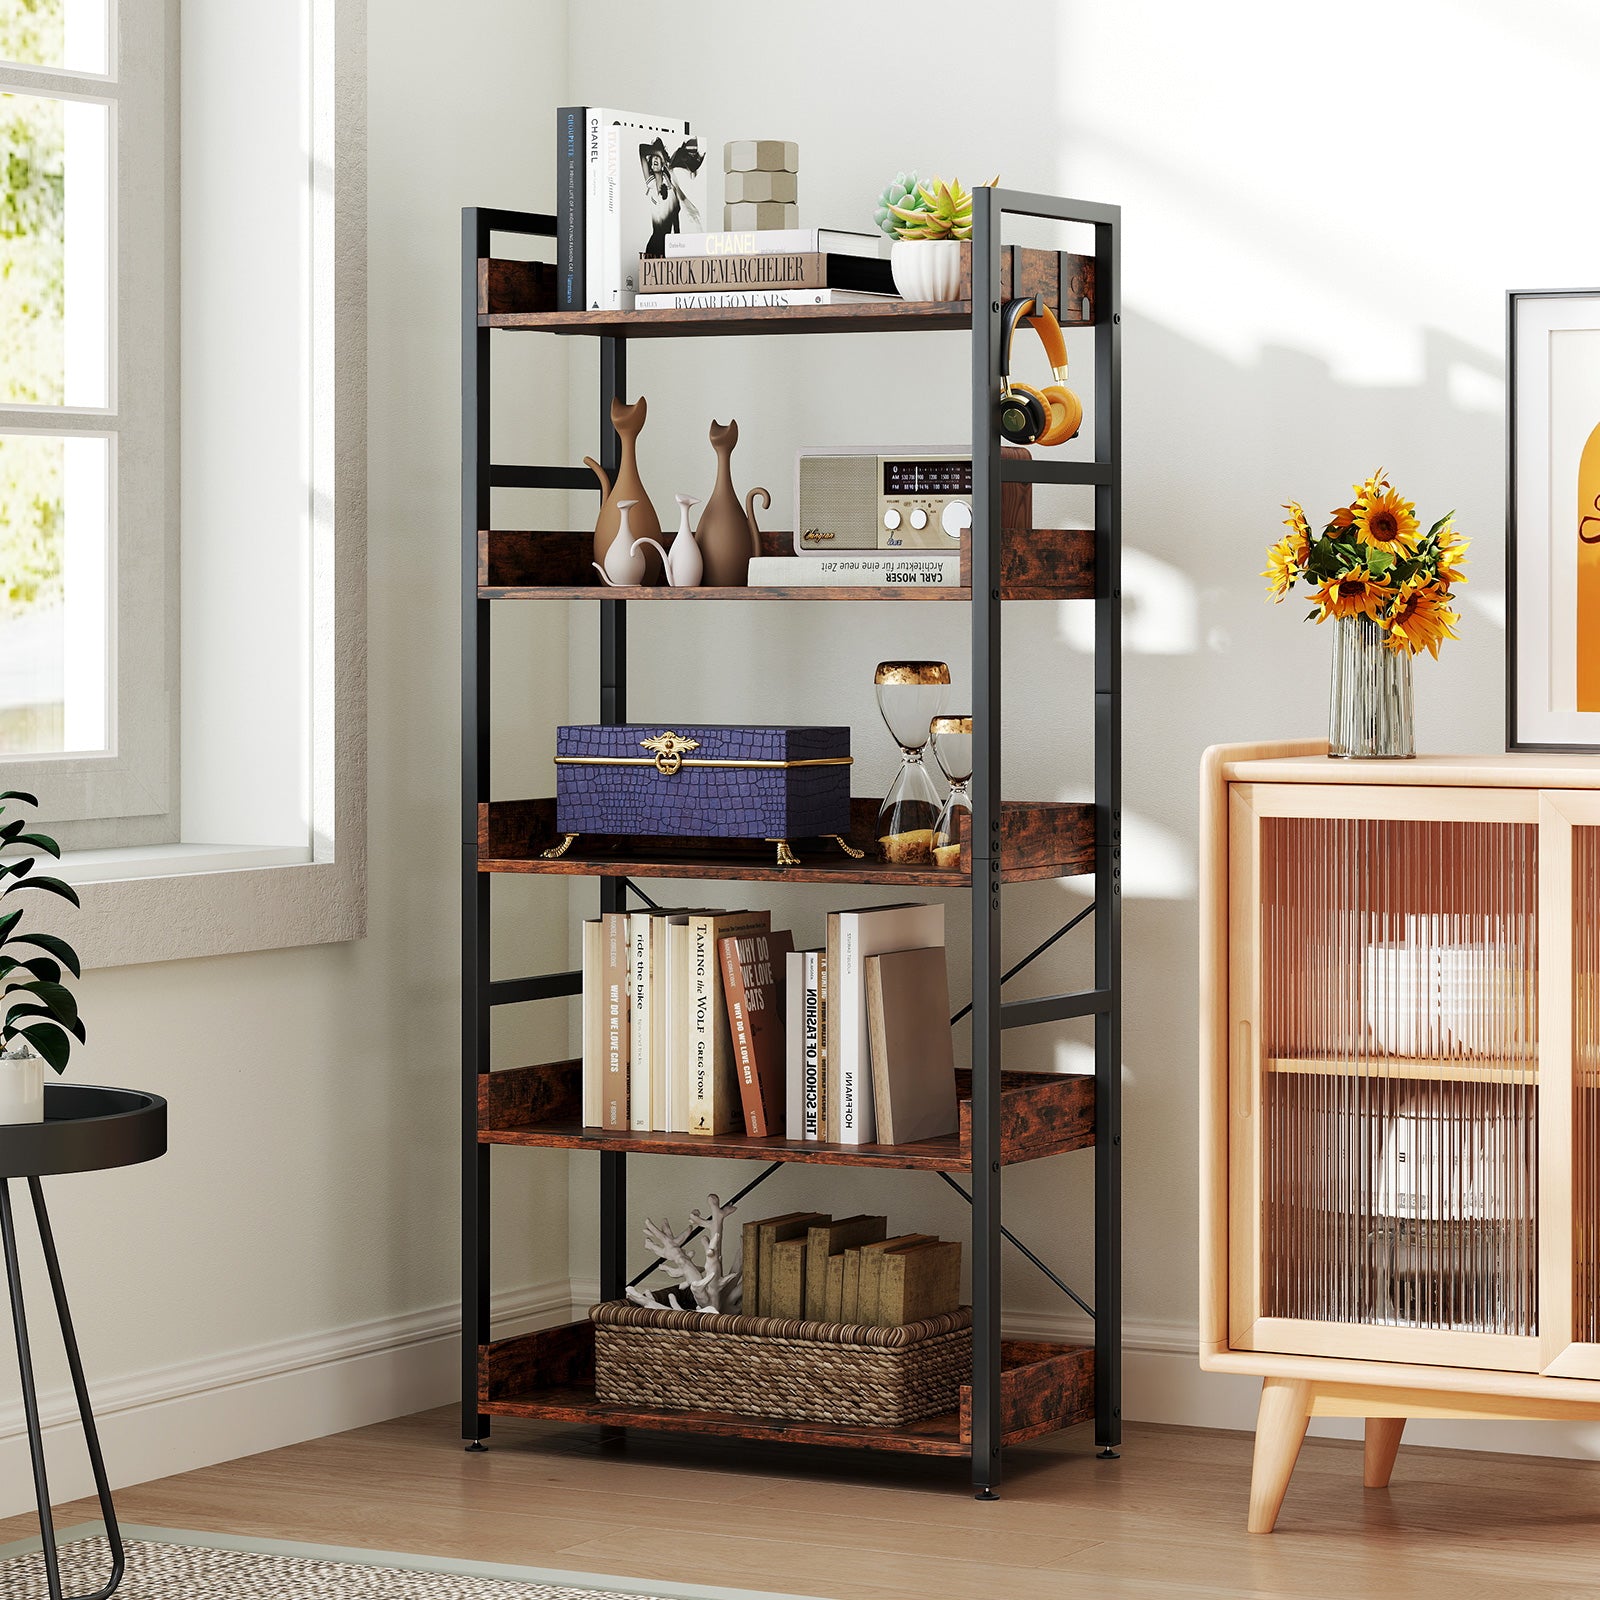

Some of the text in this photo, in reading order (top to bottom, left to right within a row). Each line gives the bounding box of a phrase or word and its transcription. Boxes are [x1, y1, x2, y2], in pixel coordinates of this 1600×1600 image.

[608, 131, 616, 176] ITALIAN
[706, 234, 759, 255] CHANEL
[644, 260, 697, 286] PATRICK
[702, 257, 804, 284] DEMARCHELIER
[675, 296, 716, 309] BAZAAR
[742, 294, 788, 307] YEARS
[821, 562, 837, 572] Zeit
[862, 562, 880, 572] eine
[882, 562, 894, 572] für
[886, 573, 943, 582] CARL MOSER
[896, 562, 943, 572] Architektur
[697, 924, 706, 976] TAMING
[739, 937, 769, 963] WHY DO
[741, 962, 774, 988] WE LOVE
[611, 1005, 618, 1015] DO
[744, 988, 765, 1012] CATS
[611, 1018, 618, 1030] WE
[697, 996, 706, 1033] WOLF
[734, 1002, 752, 1085] WHY DO WE LOVE CATS
